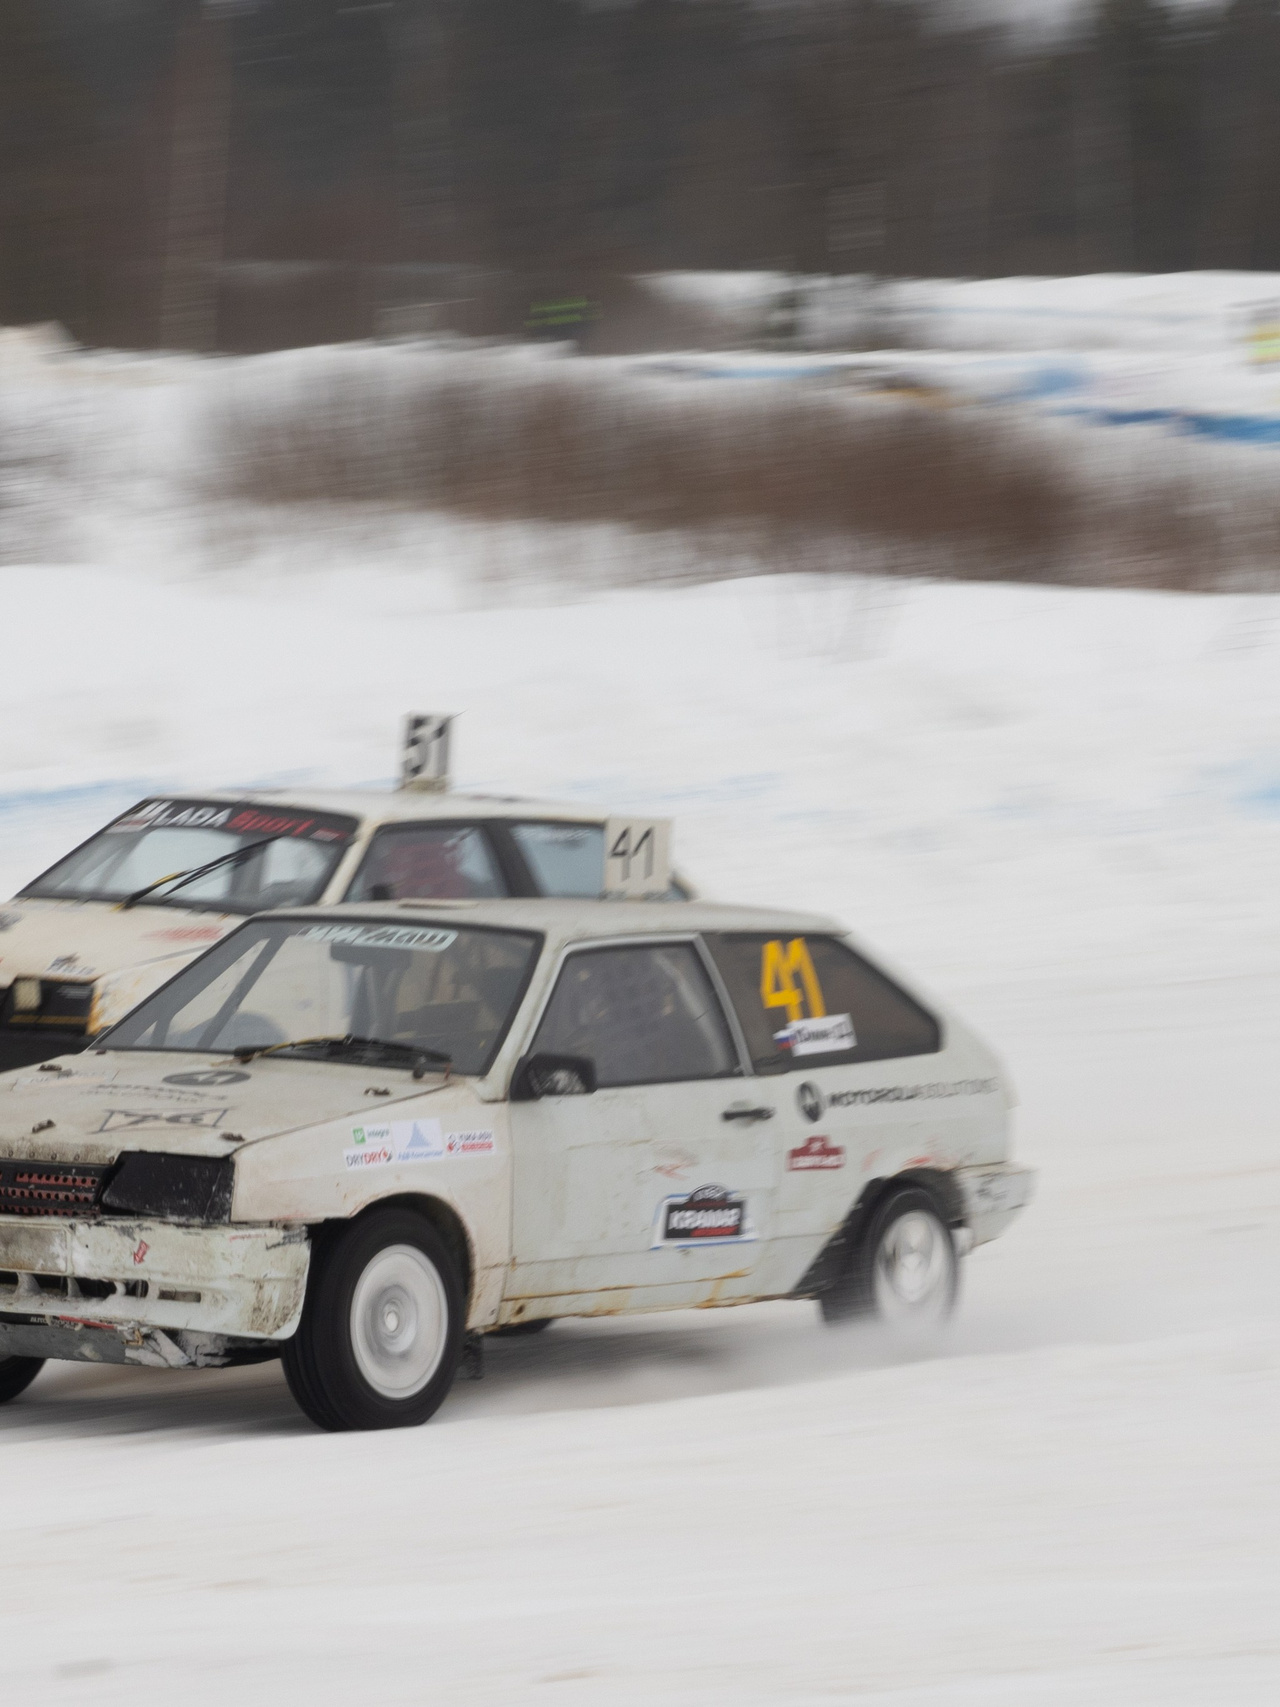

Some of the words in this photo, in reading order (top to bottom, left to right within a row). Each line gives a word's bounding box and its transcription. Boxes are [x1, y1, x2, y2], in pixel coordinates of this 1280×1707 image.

[403, 714, 450, 778] 51
[151, 806, 233, 828] LADA
[609, 827, 655, 881] 41
[762, 937, 826, 1022] 41
